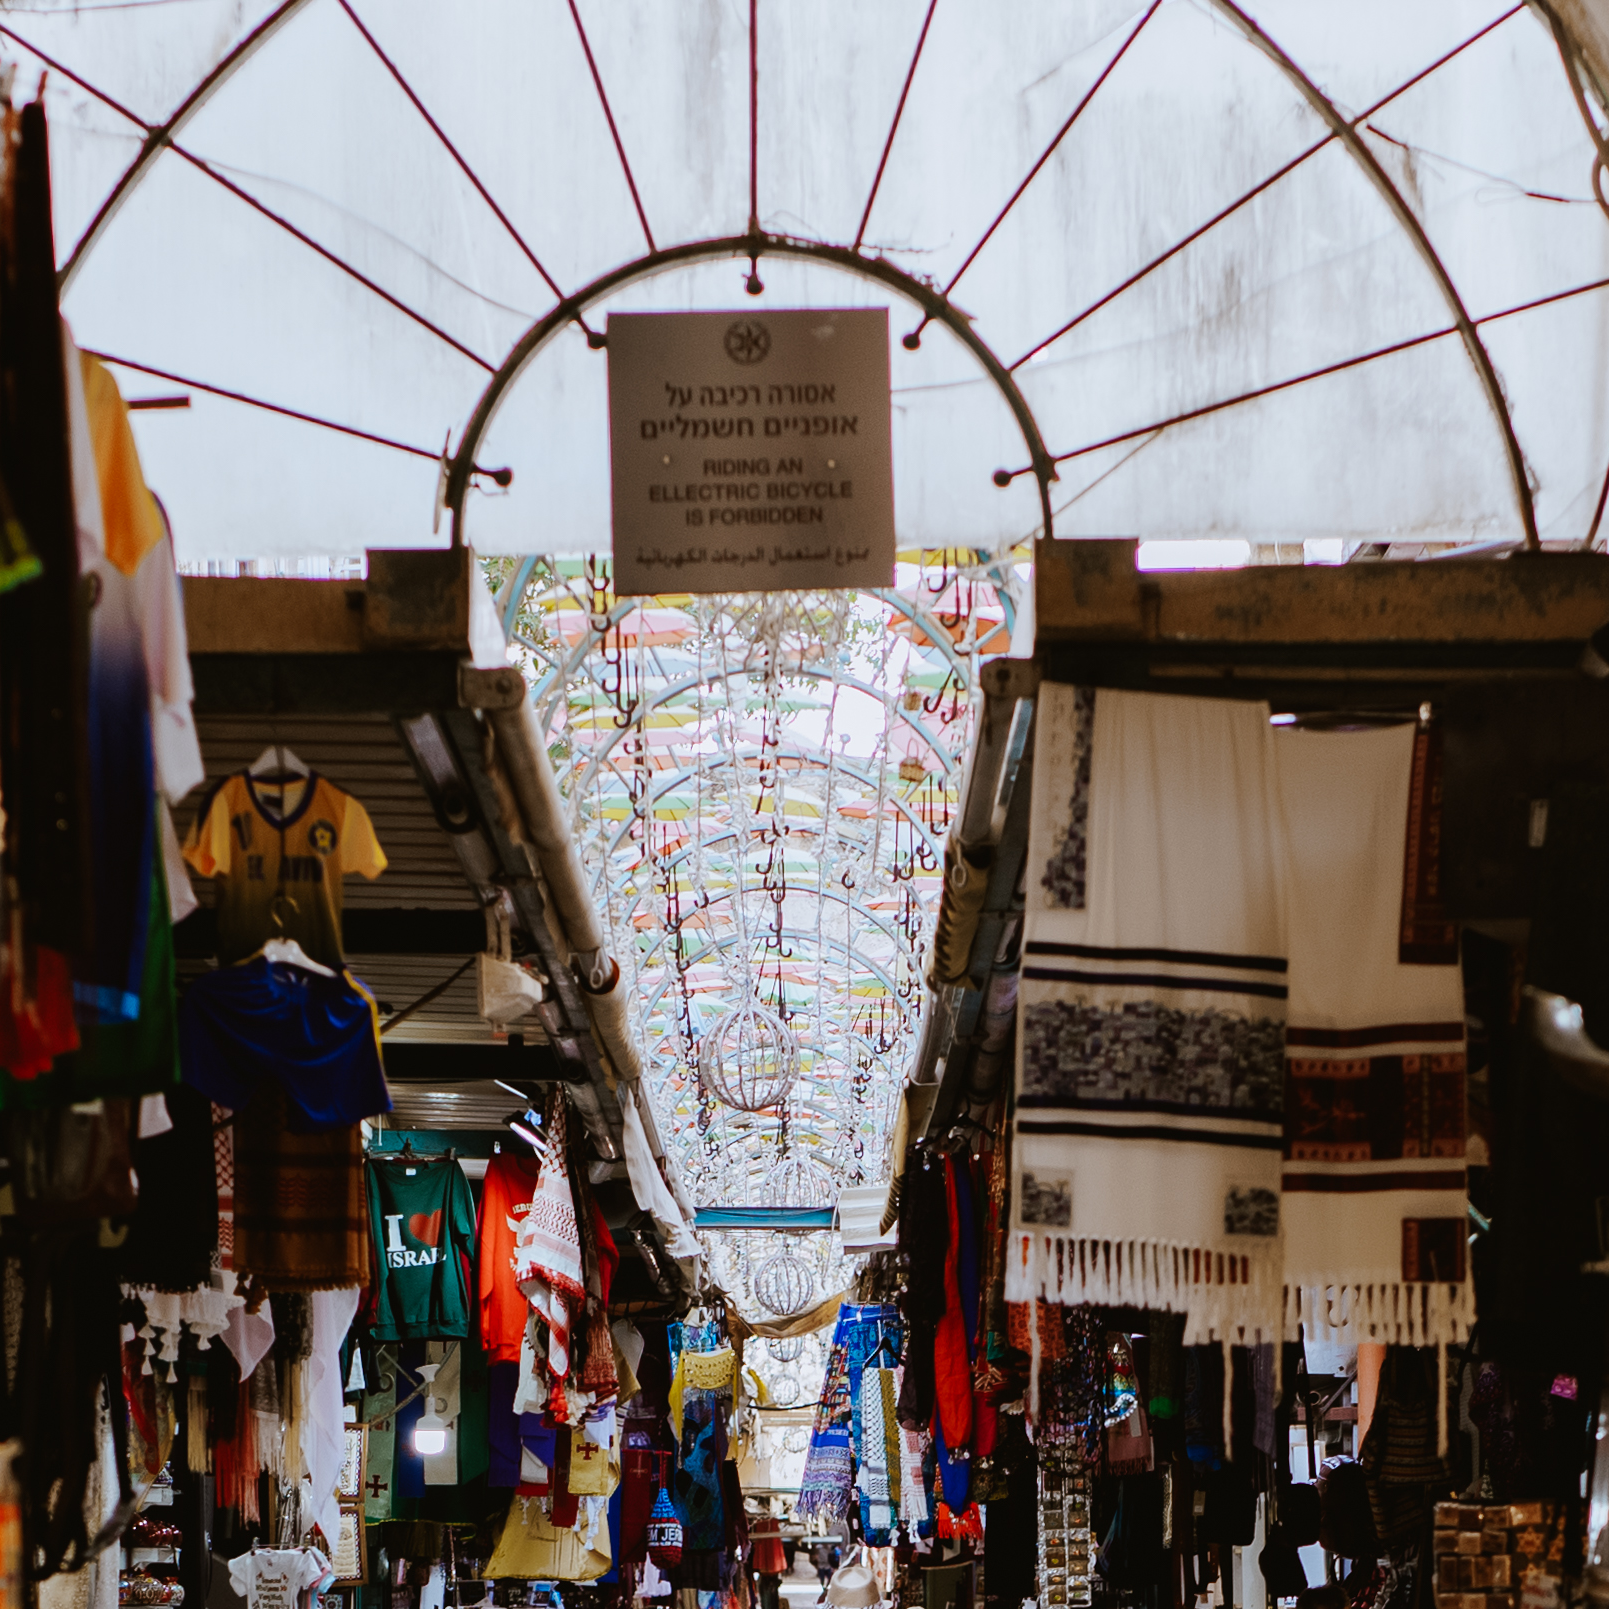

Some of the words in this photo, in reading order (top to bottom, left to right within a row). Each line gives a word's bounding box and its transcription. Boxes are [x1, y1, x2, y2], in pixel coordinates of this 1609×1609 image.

[665, 382, 692, 408] על
[700, 385, 762, 407] רכיבה
[768, 383, 836, 406] אסורה
[641, 413, 755, 440] חשמליים
[764, 415, 858, 437] אופניים
[703, 458, 770, 476] RIDING
[776, 458, 803, 475] AN
[649, 483, 761, 502] ELLECTRIC
[767, 480, 853, 499] BICYCLE
[685, 508, 703, 526] IS
[709, 506, 823, 525] FORBIDDEN
[384, 1214, 406, 1252] I
[387, 1247, 447, 1269] ISRAEL
